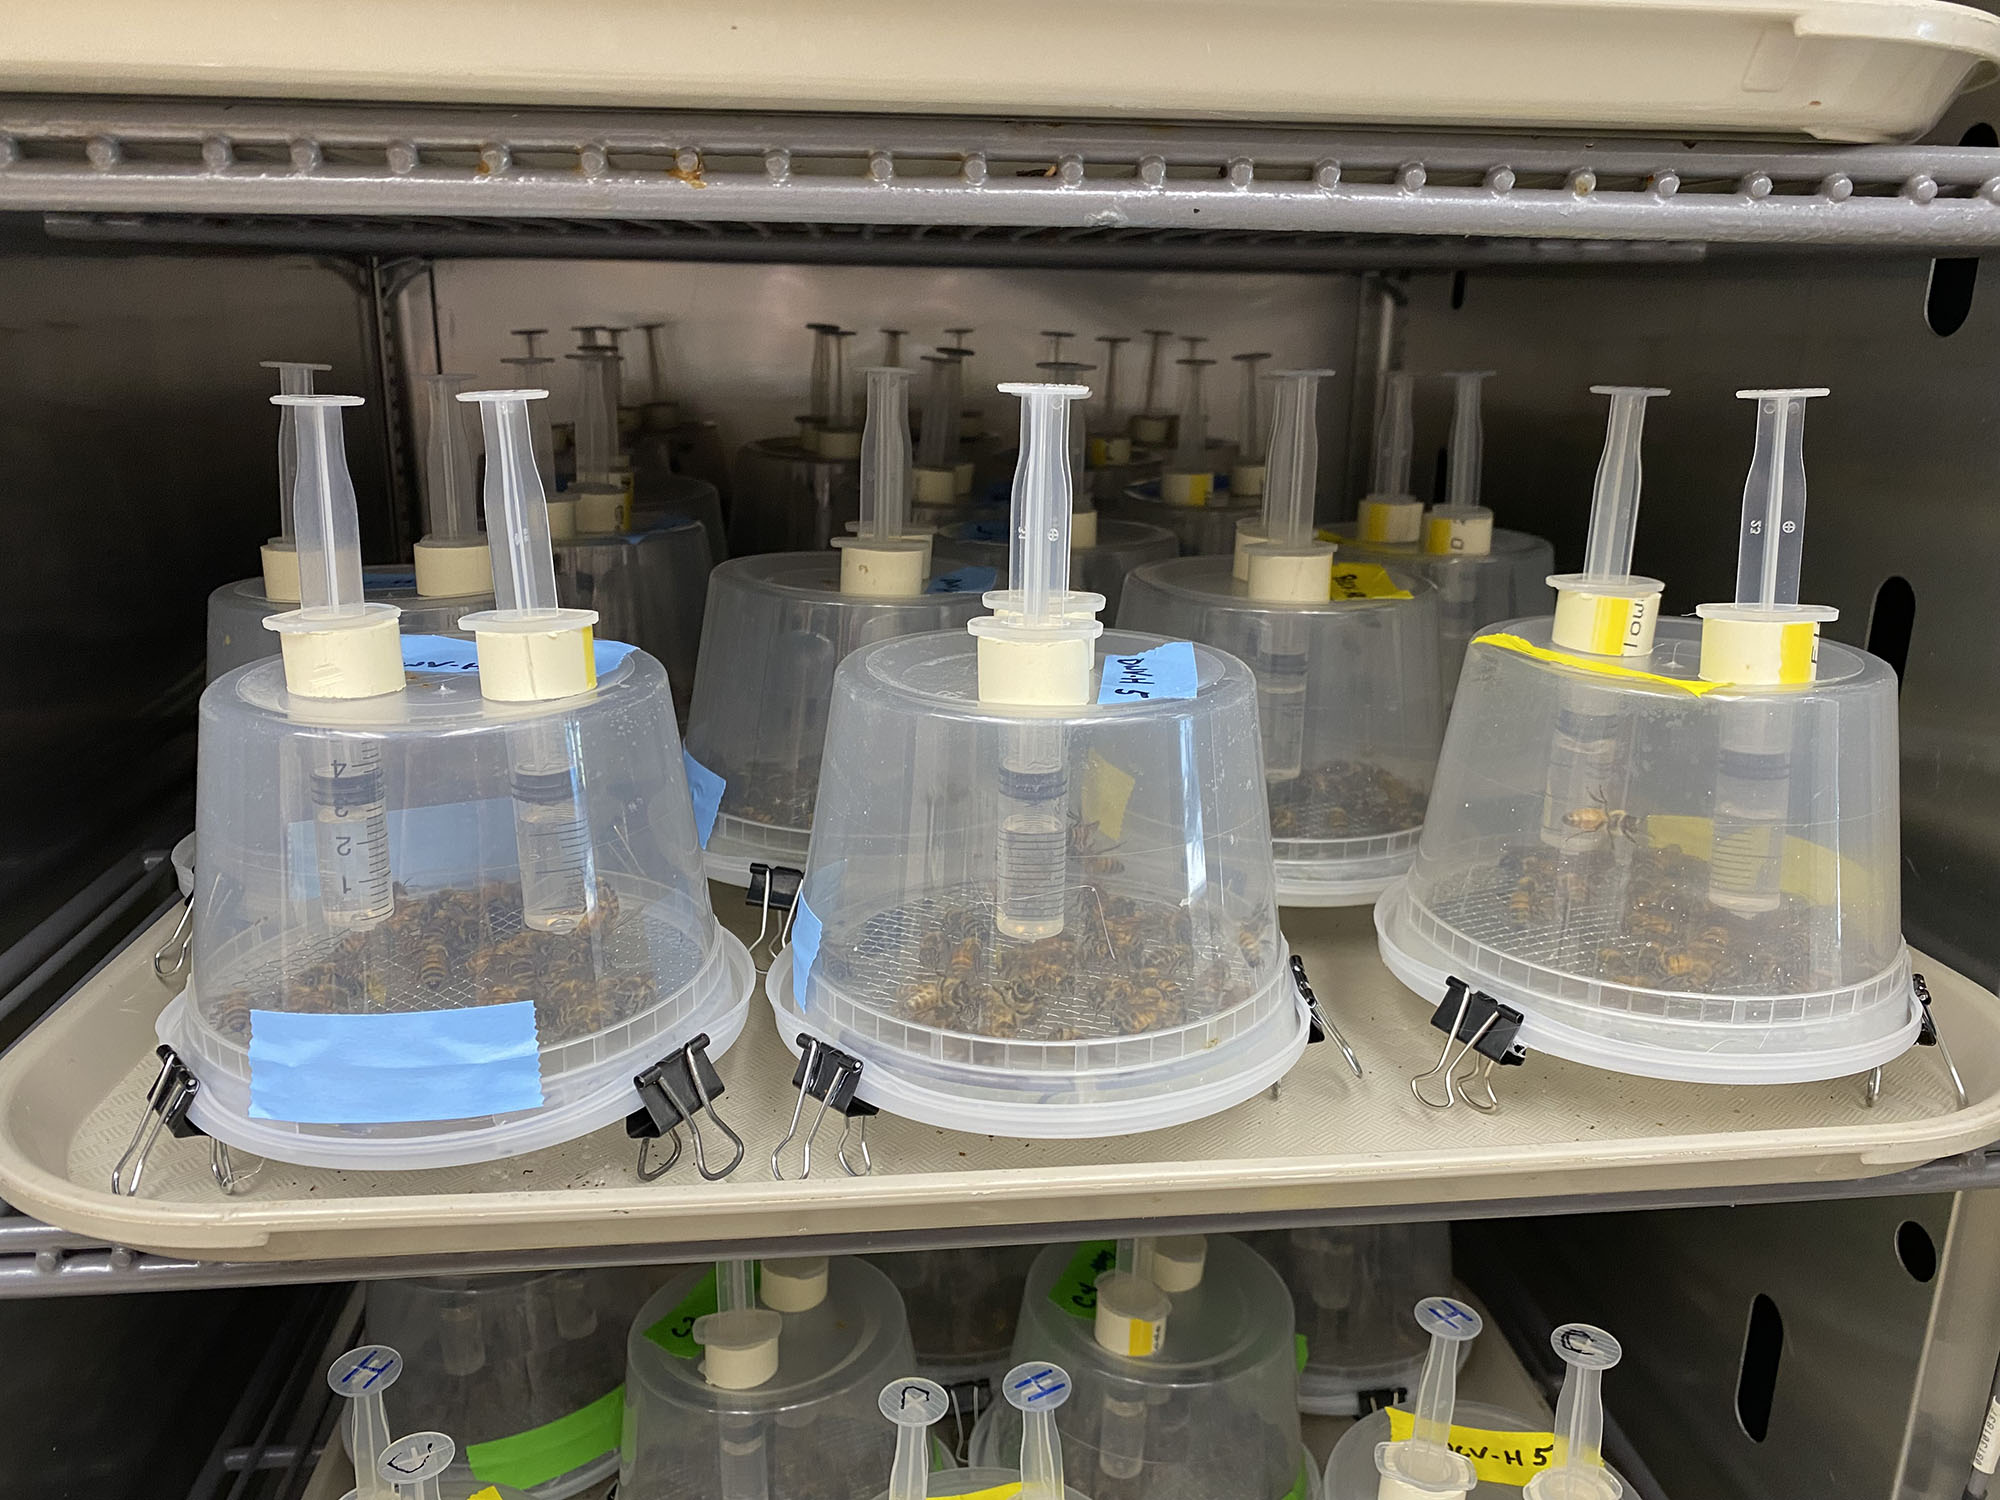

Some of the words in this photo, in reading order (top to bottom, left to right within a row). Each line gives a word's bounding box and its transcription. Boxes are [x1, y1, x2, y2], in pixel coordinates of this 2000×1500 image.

[1623, 599, 1645, 648] low
[331, 759, 347, 779] 4
[335, 836, 351, 857] 2
[342, 875, 352, 894] 1
[1428, 1299, 1474, 1331] H
[1560, 1329, 1598, 1356] C
[341, 1349, 395, 1390] H
[1014, 1368, 1067, 1403] H
[1533, 1444, 1555, 1467] 5
